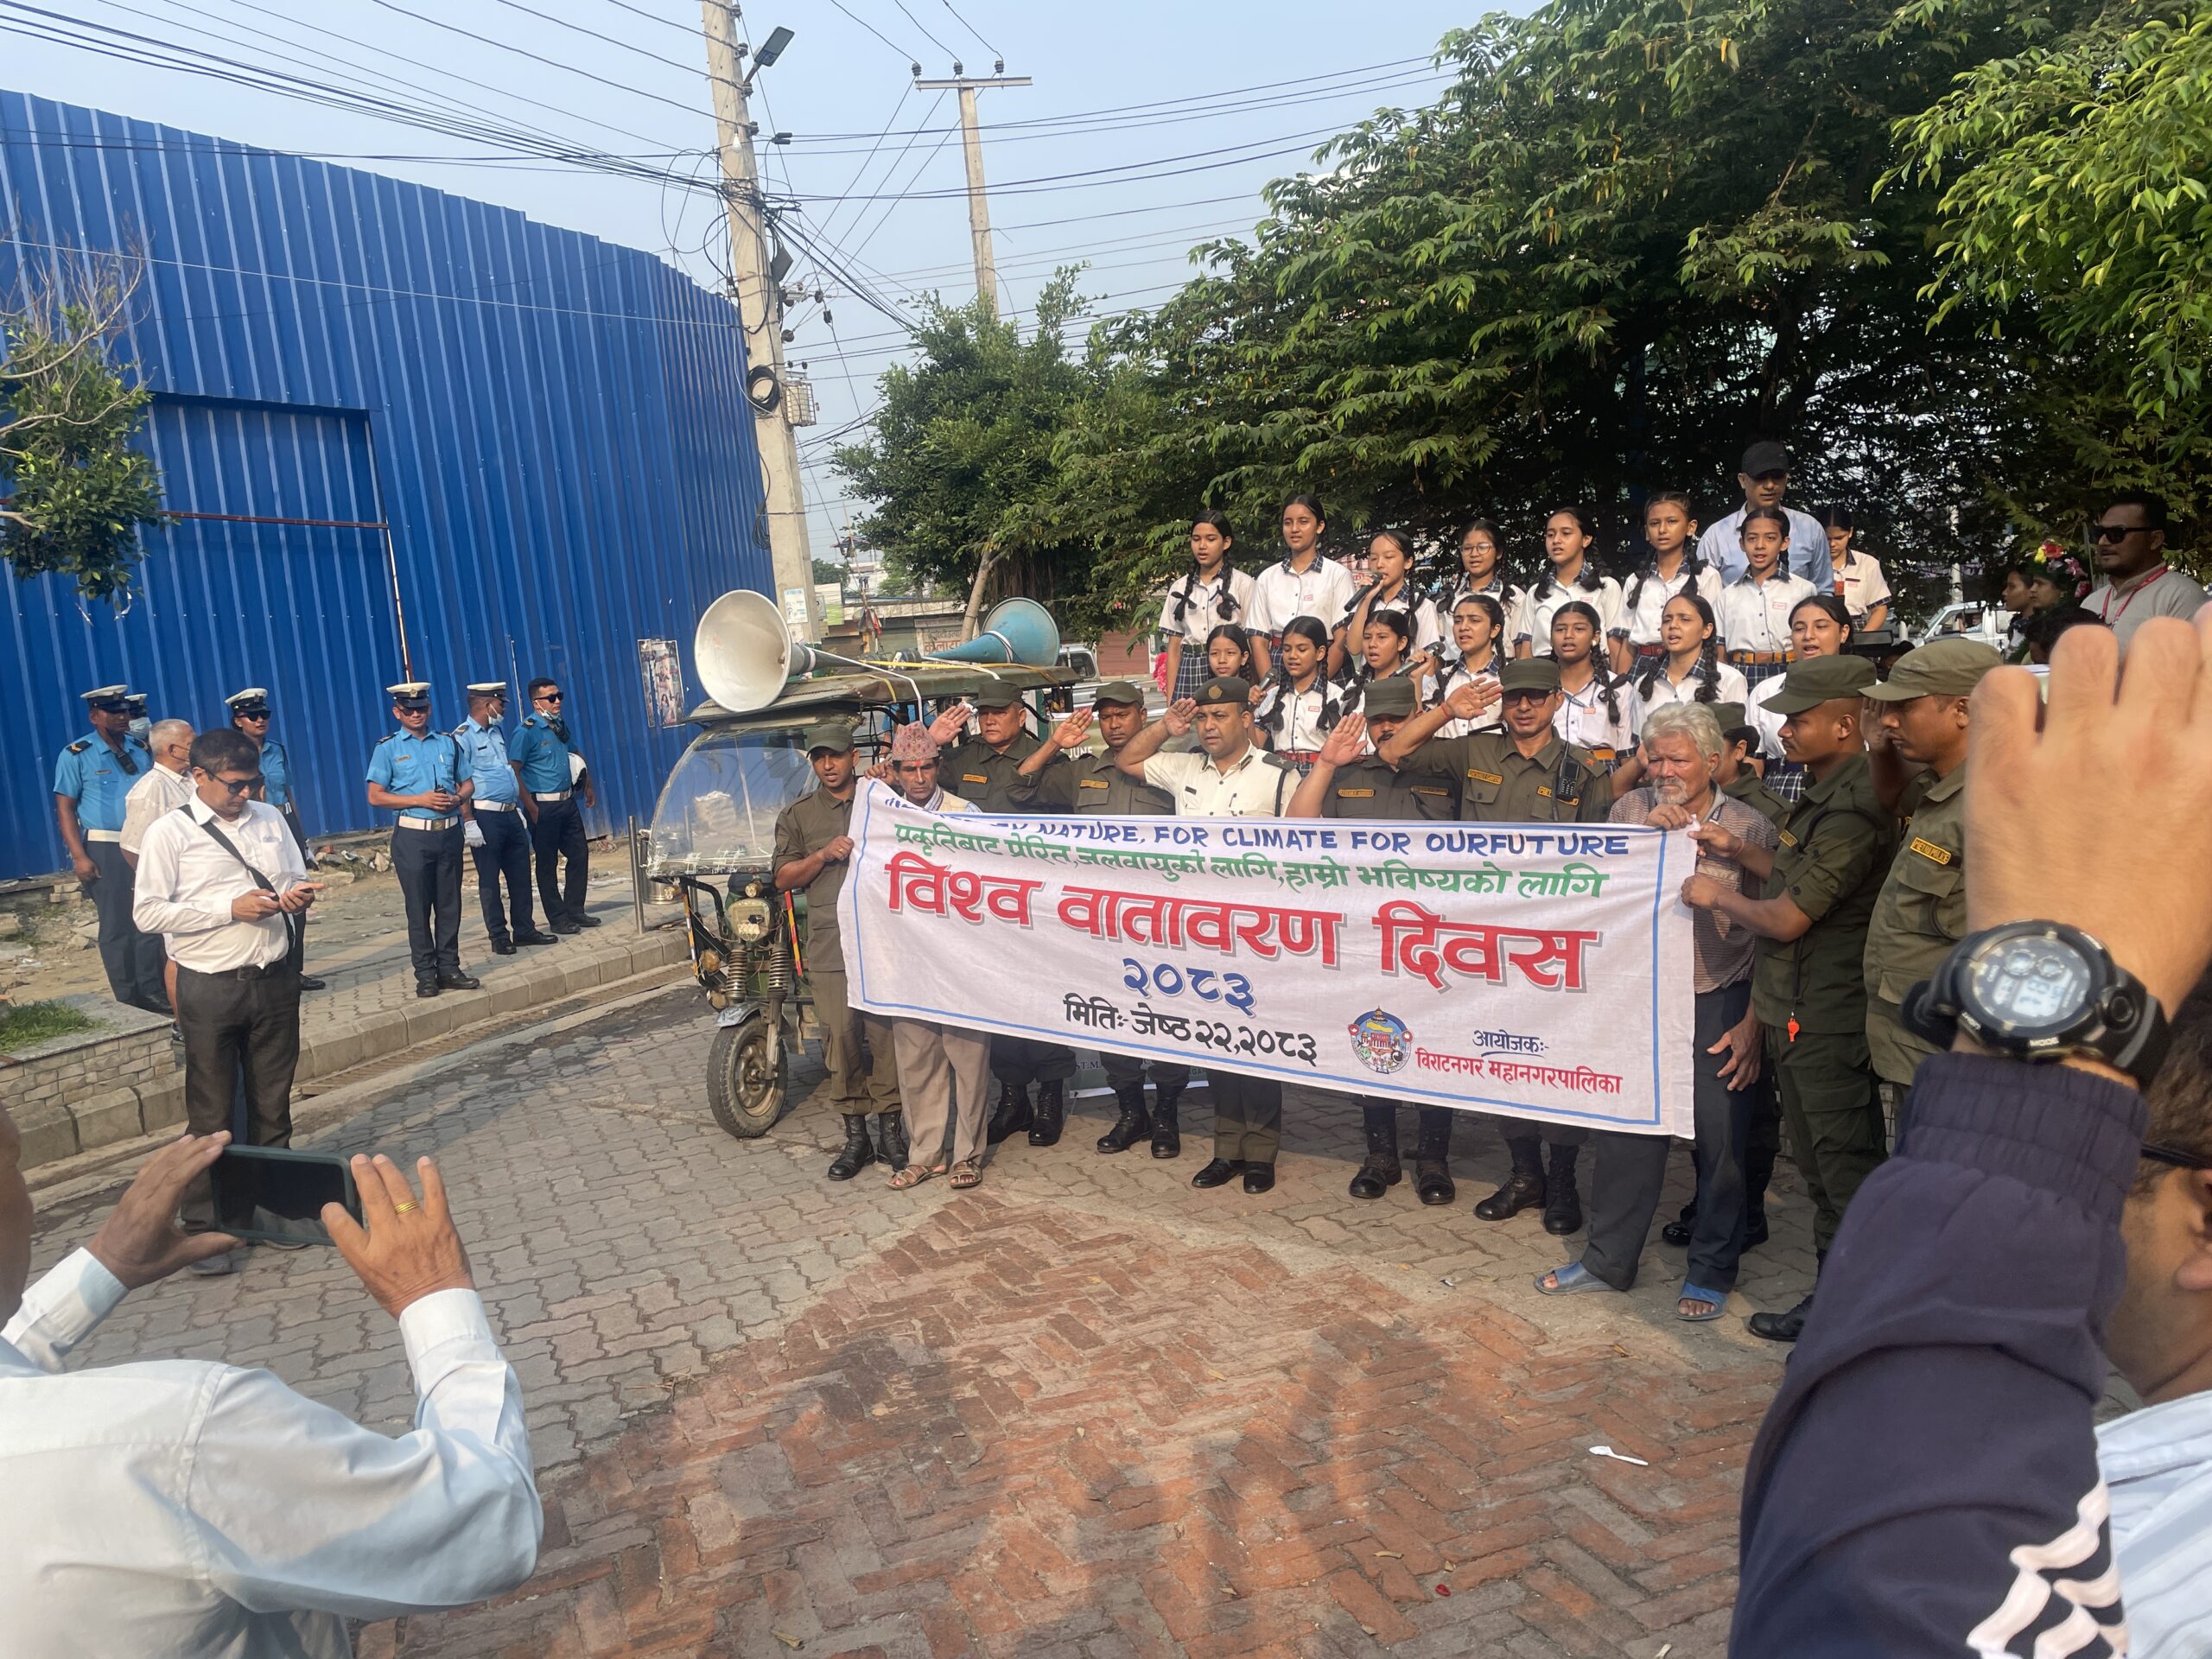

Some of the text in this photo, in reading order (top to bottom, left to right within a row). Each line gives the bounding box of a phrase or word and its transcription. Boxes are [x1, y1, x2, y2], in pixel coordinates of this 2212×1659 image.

[1154, 826, 1209, 847] FOR
[1223, 827, 1338, 851] CLIMATE
[1351, 831, 1411, 855] FOR
[1356, 859, 1513, 893] भविष्यको
[1518, 862, 1611, 899] लागि
[884, 851, 1603, 992] विश्व वातावरण दिवस
[1122, 957, 1257, 1018] २०८३
[1414, 1047, 1484, 1078] विराटनगर
[1488, 1059, 1624, 1094] महानगरपालिका
